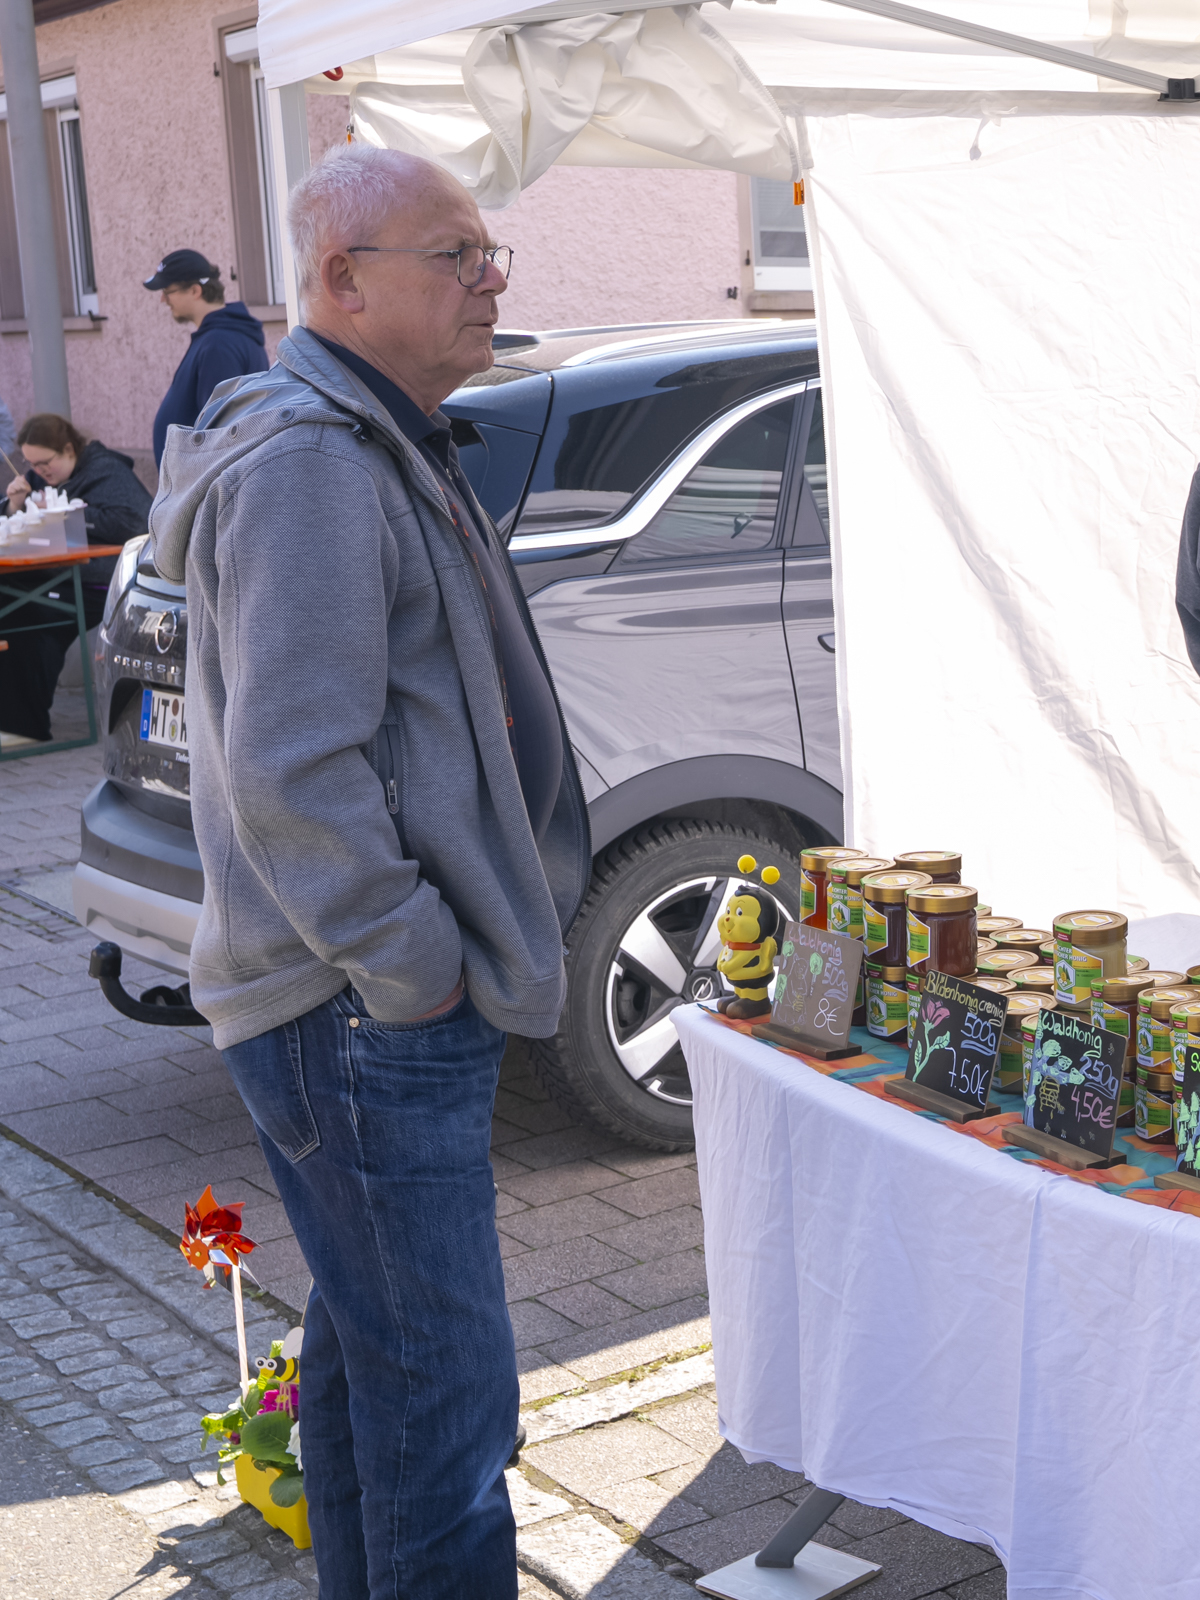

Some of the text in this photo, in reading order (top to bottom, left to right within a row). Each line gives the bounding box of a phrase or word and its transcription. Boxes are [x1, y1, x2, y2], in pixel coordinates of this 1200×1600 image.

[151, 697, 170, 738] WT
[789, 924, 842, 966] Waldhonig
[1069, 955, 1087, 963] HONIG
[822, 963, 849, 1002] 500g
[924, 971, 979, 1015] Blütenhonig
[814, 998, 844, 1035] 8€
[961, 1012, 997, 1056] 500g
[1042, 1011, 1102, 1058] Waldhonig
[945, 1046, 989, 1105] 7.50€
[1080, 1055, 1119, 1100] 250g
[1071, 1085, 1114, 1129] 4,50€
